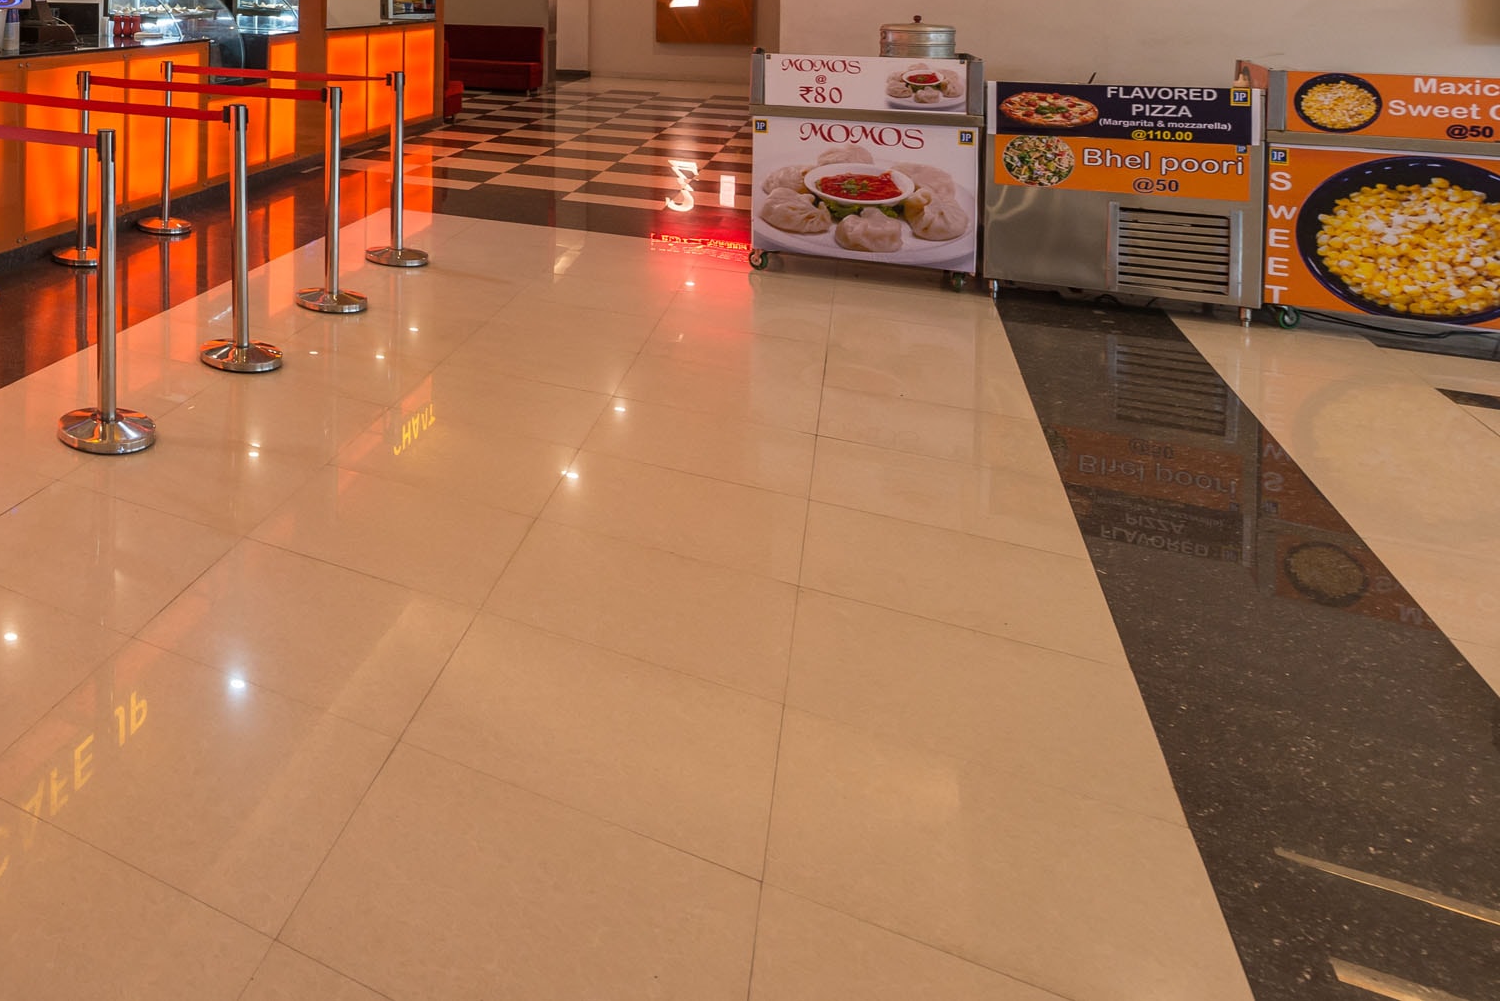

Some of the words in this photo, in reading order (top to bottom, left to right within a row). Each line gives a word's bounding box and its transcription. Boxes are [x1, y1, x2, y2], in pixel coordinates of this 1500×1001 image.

[781, 58, 861, 75] MOMOS
[815, 74, 827, 85] @
[1413, 77, 1500, 97] Maxic
[1107, 86, 1218, 101] FLAVORED
[1131, 104, 1193, 118] PIZZA
[1388, 99, 1481, 120] Sweet
[1099, 118, 1154, 128] (Margarita
[1156, 120, 1165, 128] &
[1167, 121, 1231, 131] mozzarella)
[1446, 124, 1494, 140] @50
[800, 122, 924, 149] MOMOS
[1131, 129, 1193, 141] @110.00
[1082, 148, 1151, 170] Bhel
[1160, 156, 1245, 176] poori
[1132, 177, 1180, 194] @50
[1264, 171, 1297, 304] SWEET
